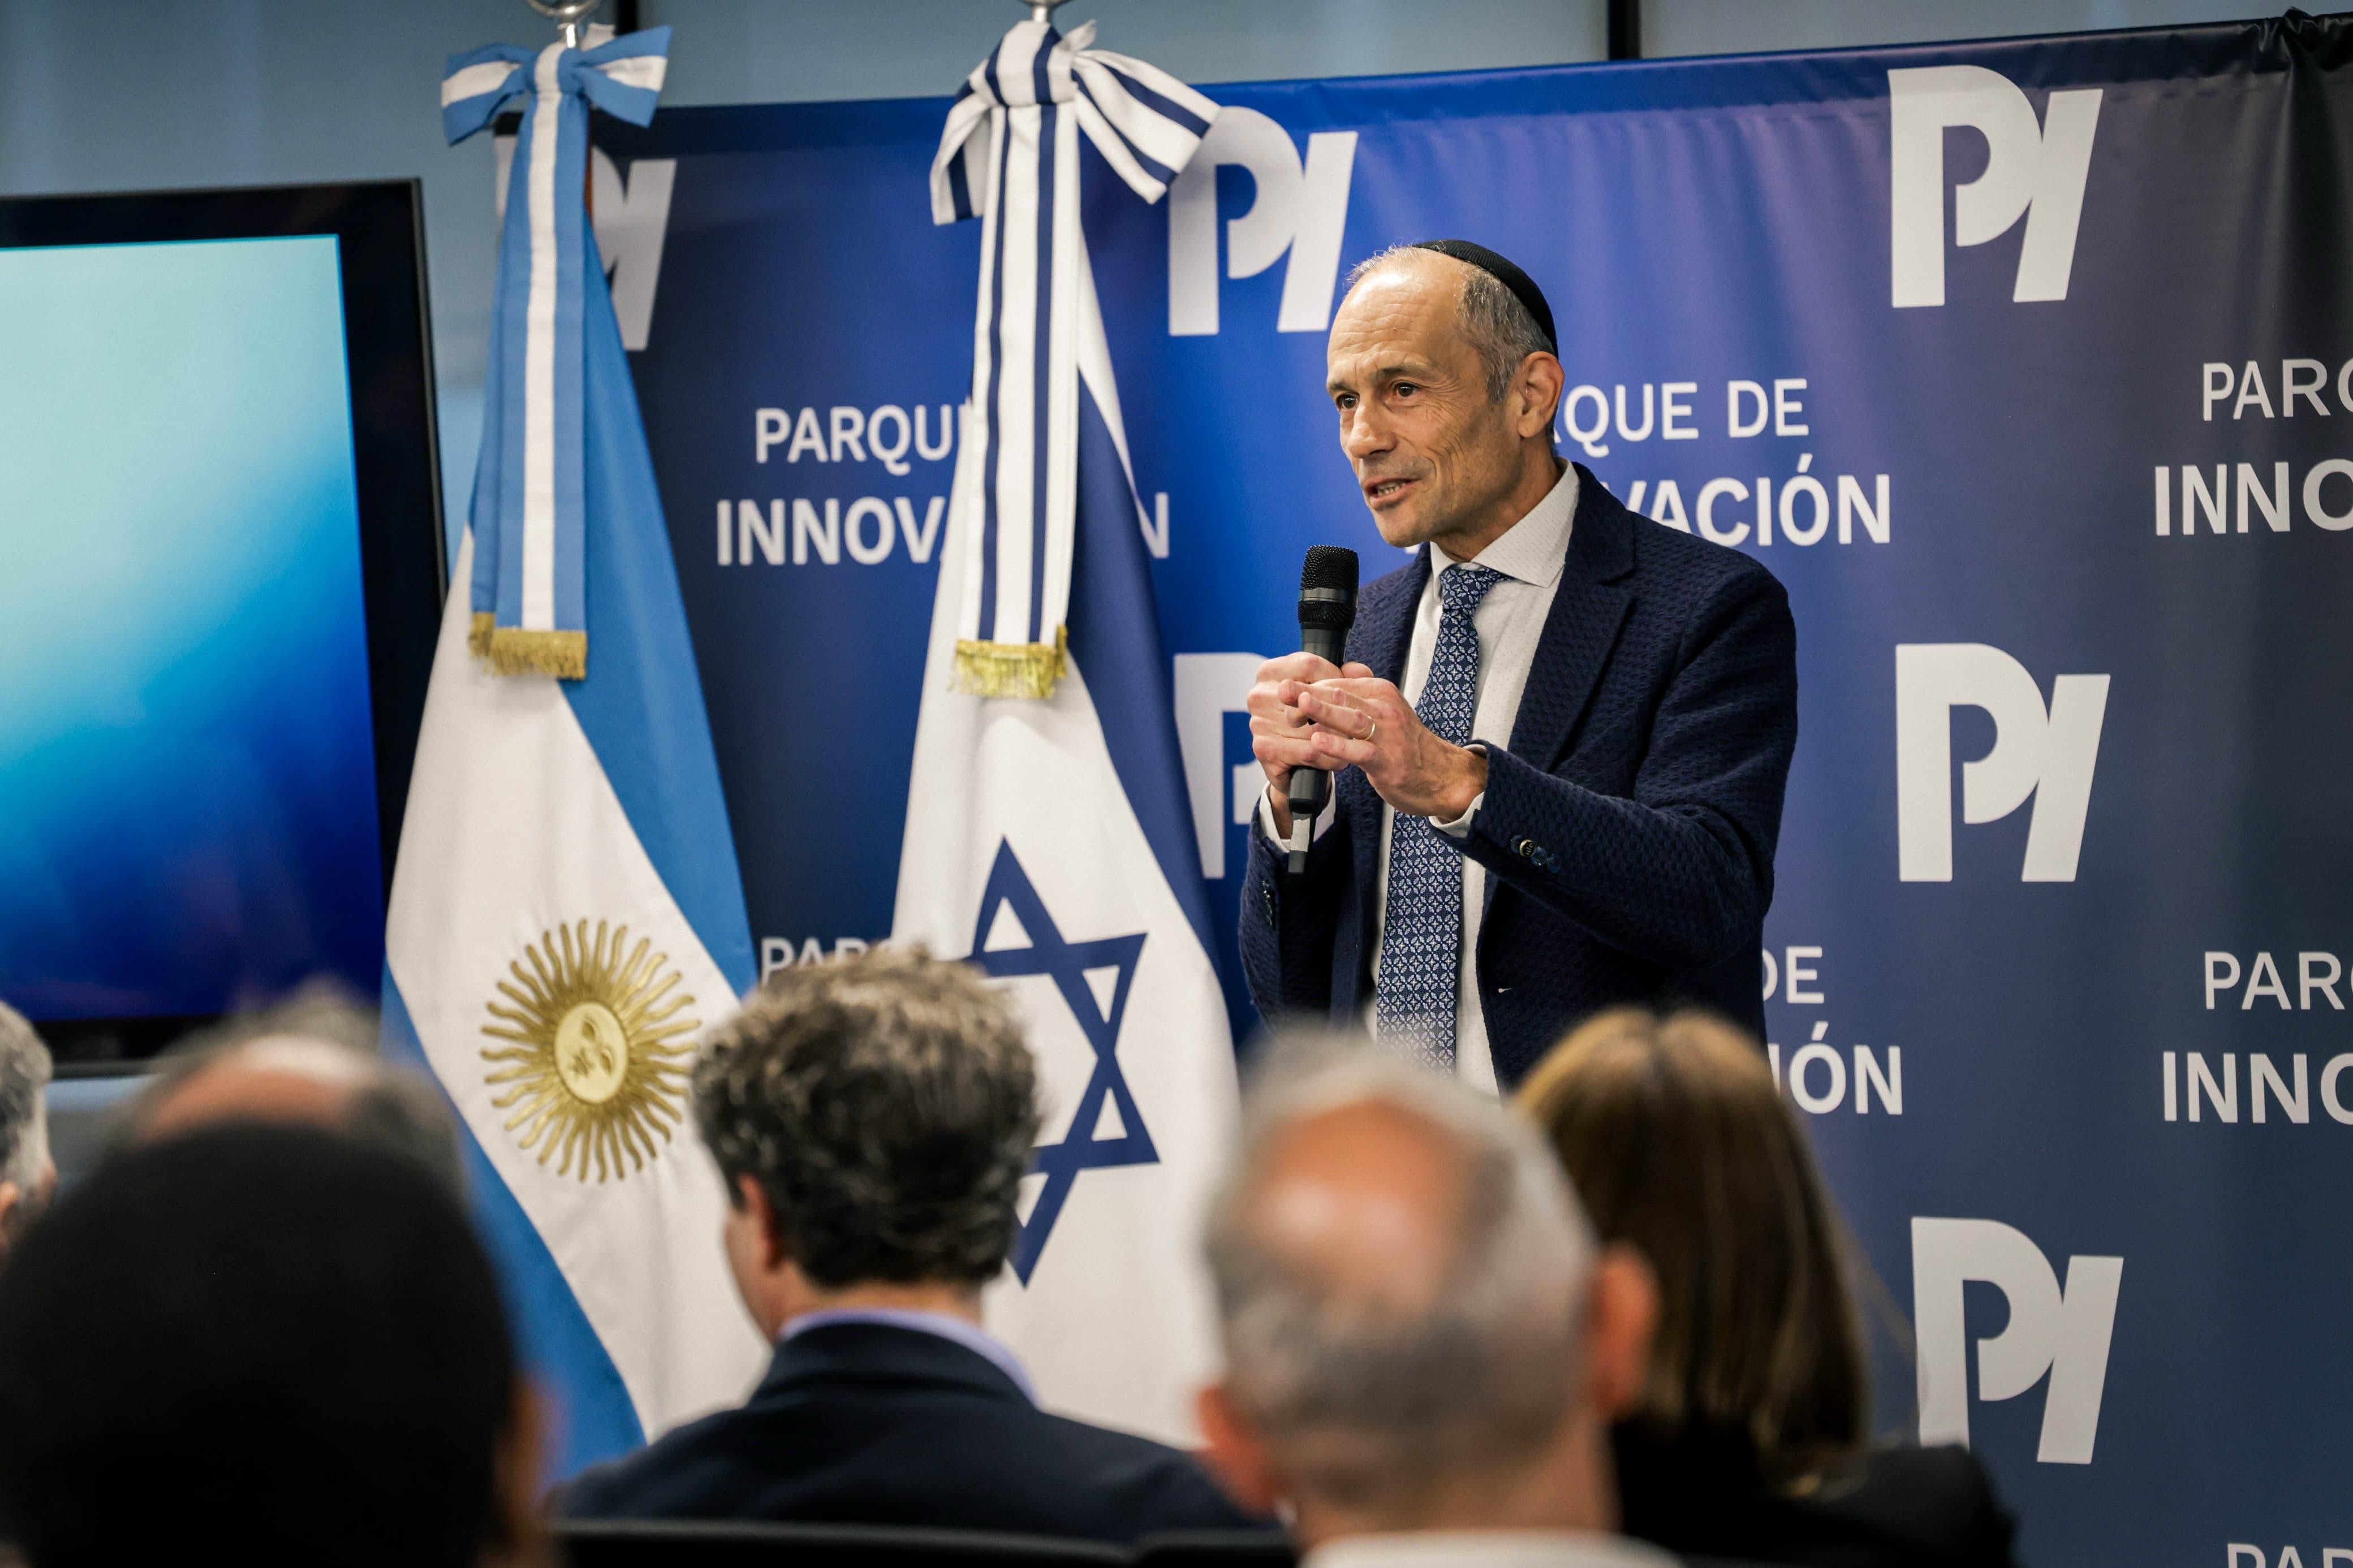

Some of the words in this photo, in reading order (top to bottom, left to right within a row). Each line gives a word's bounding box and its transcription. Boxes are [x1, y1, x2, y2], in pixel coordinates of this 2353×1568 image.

[756, 404, 970, 476] PARQU
[1554, 382, 1699, 458] QUE
[1728, 378, 1809, 438] DE
[2154, 458, 2353, 537] INNO
[2204, 951, 2353, 1010] PAR
